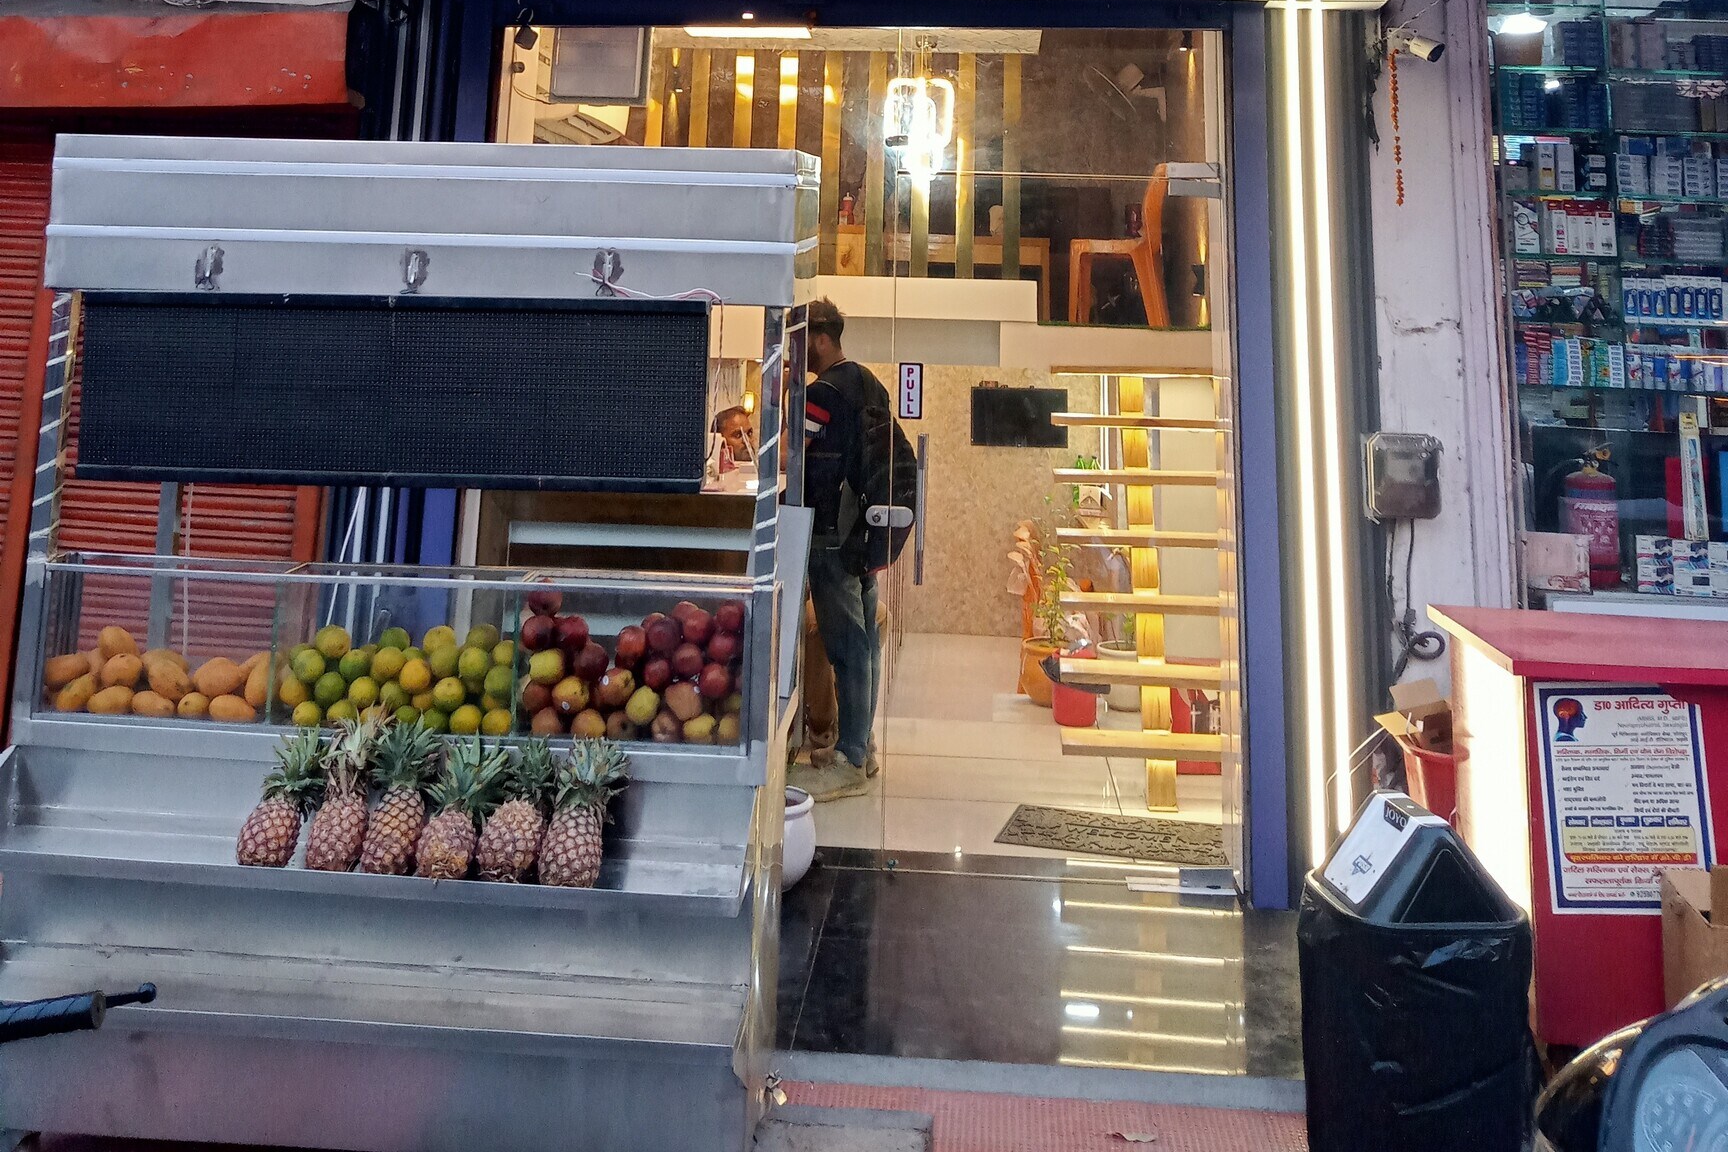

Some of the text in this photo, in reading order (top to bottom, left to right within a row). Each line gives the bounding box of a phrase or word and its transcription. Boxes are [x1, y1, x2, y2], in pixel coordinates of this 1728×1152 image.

[906, 367, 915, 415] PULL
[1614, 696, 1655, 710] आदित्य
[1657, 698, 1686, 715] गुप्ता
[1385, 807, 1407, 828] JOYO
[1066, 824, 1174, 844] WELCOME
